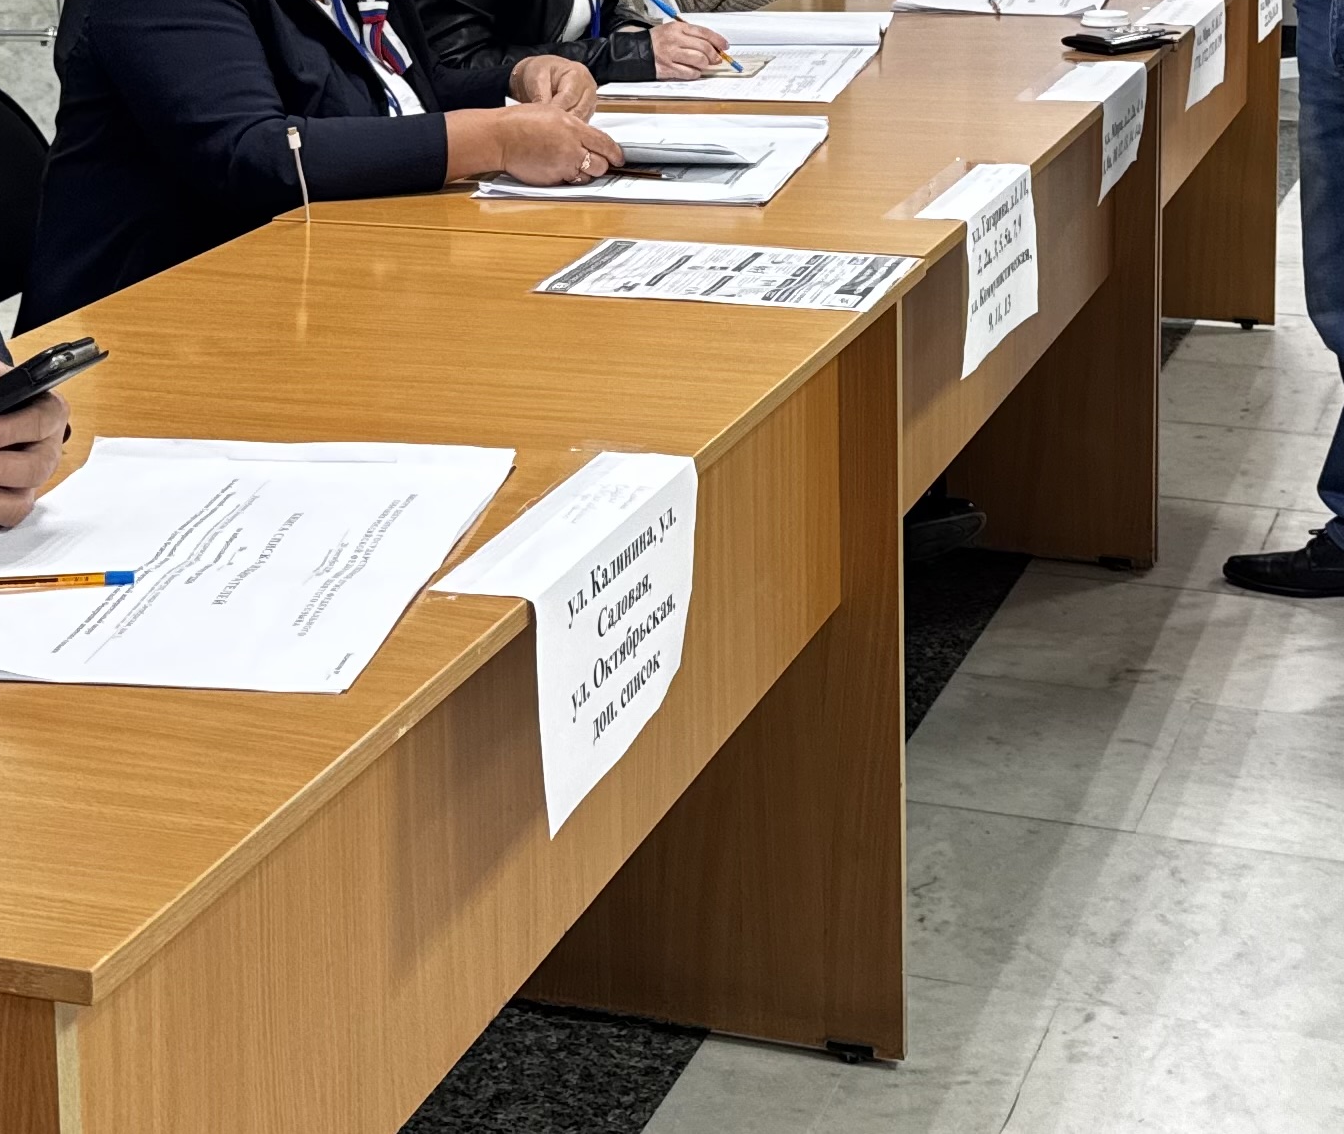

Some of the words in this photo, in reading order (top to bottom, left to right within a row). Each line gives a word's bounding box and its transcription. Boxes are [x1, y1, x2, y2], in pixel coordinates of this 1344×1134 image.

[972, 230, 981, 252] ул.
[567, 590, 587, 629] ул.
[590, 525, 657, 600] Калинина,
[659, 507, 677, 543] ул.
[597, 573, 652, 638] Садовая,
[571, 682, 590, 723] ул.
[593, 594, 676, 689] Октябрьская,
[593, 703, 617, 746] доп.
[620, 650, 661, 709] список
